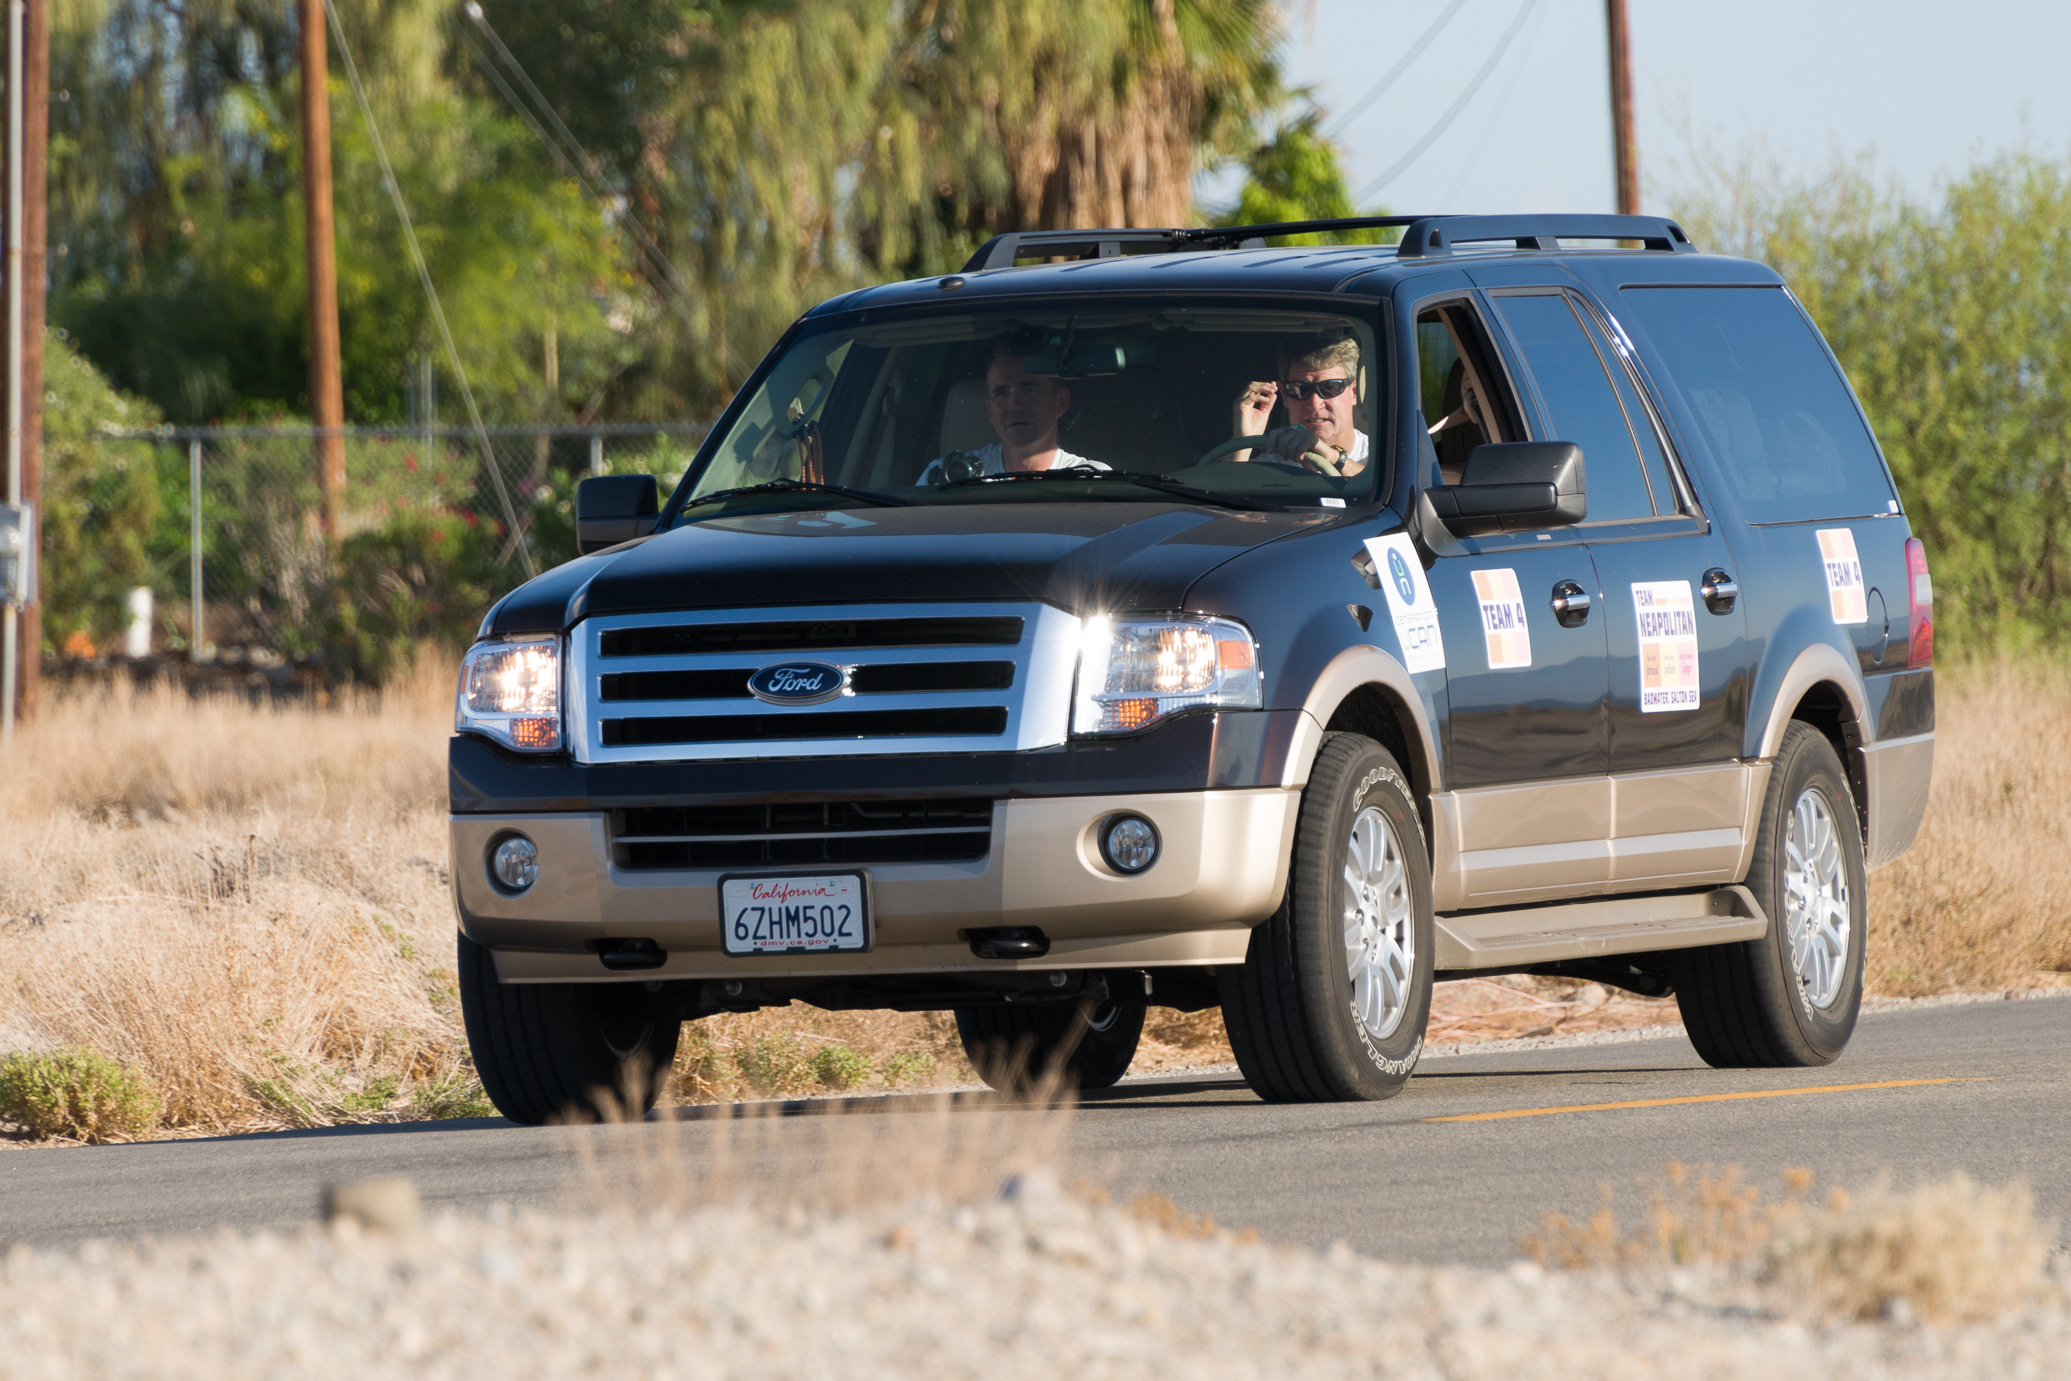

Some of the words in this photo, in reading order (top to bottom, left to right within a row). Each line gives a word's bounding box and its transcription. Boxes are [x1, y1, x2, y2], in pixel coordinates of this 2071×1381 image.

[1826, 562, 1853, 587] TEAM
[1853, 561, 1862, 586] 4
[1636, 589, 1655, 607] TEAM
[1482, 603, 1514, 630] TEAM
[1516, 602, 1525, 628] 4
[1639, 610, 1694, 637] NEAPOLITAN
[768, 667, 824, 692] Ford
[1689, 690, 1698, 703] SEA
[752, 882, 836, 904] California
[734, 903, 853, 941] 6ZHM502
[760, 939, 829, 947] dmv.ca.gov
